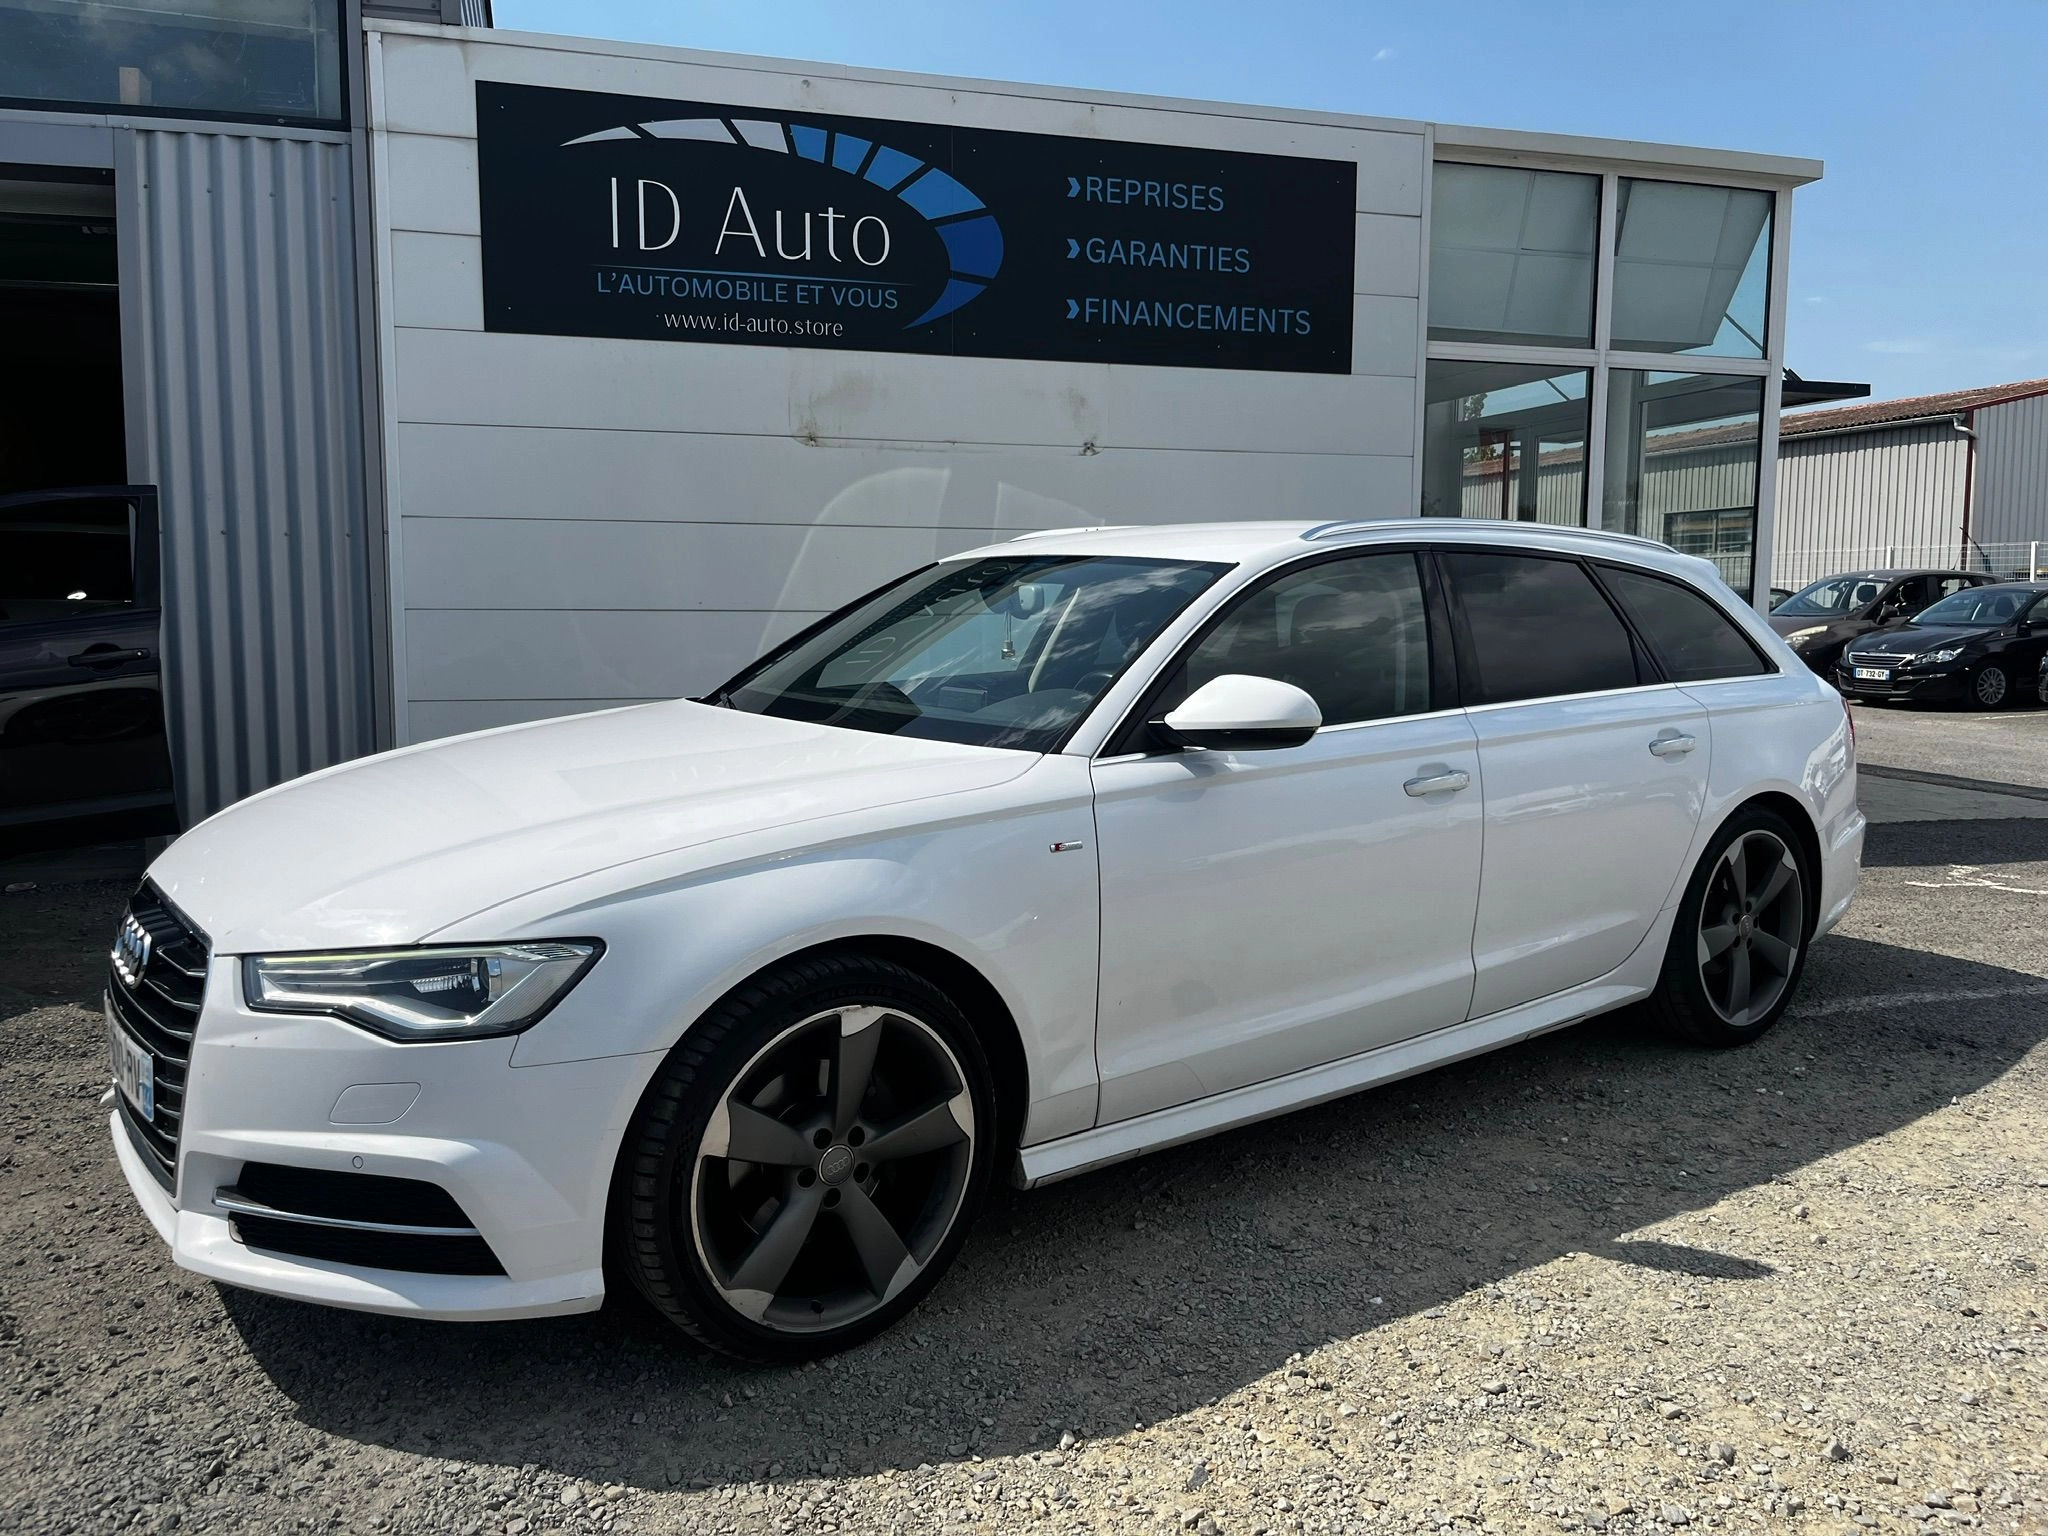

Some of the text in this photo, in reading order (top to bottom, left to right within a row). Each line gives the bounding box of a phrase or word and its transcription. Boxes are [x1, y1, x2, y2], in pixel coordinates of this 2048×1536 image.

[1085, 176, 1224, 212] REPRISES
[611, 177, 891, 266] ID Auto
[1085, 237, 1251, 273] GARANTIES
[796, 284, 824, 306] ET
[830, 286, 898, 309] VOUS
[664, 312, 844, 337] www.id-auto.store
[1085, 298, 1311, 335] FINANCEMENTS
